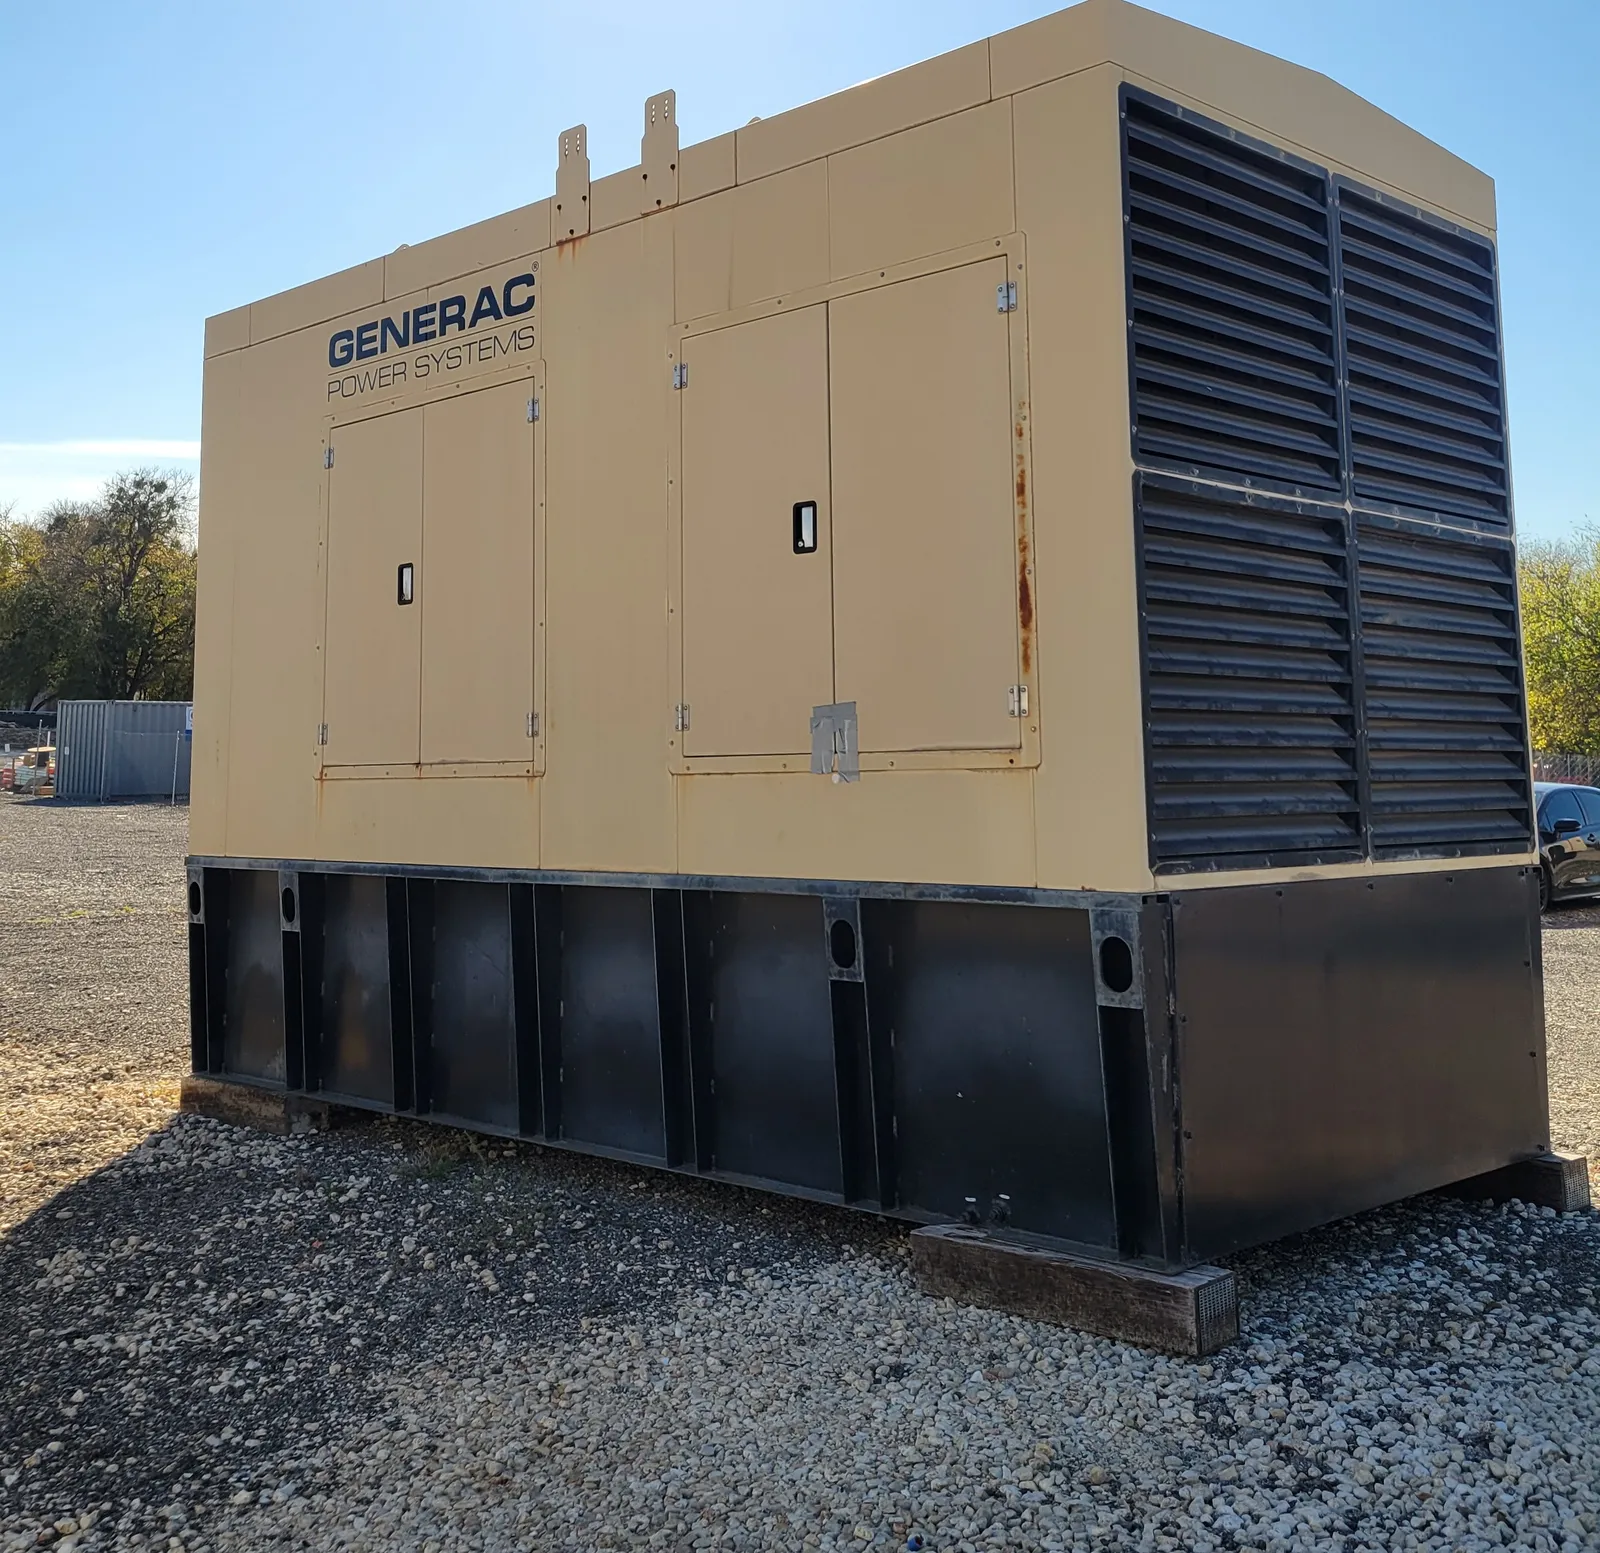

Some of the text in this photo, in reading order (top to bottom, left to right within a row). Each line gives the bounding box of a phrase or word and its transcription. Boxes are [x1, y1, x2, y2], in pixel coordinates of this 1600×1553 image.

[327, 325, 535, 402] POWER SYSTEMS
[329, 273, 535, 368] GENERAC
